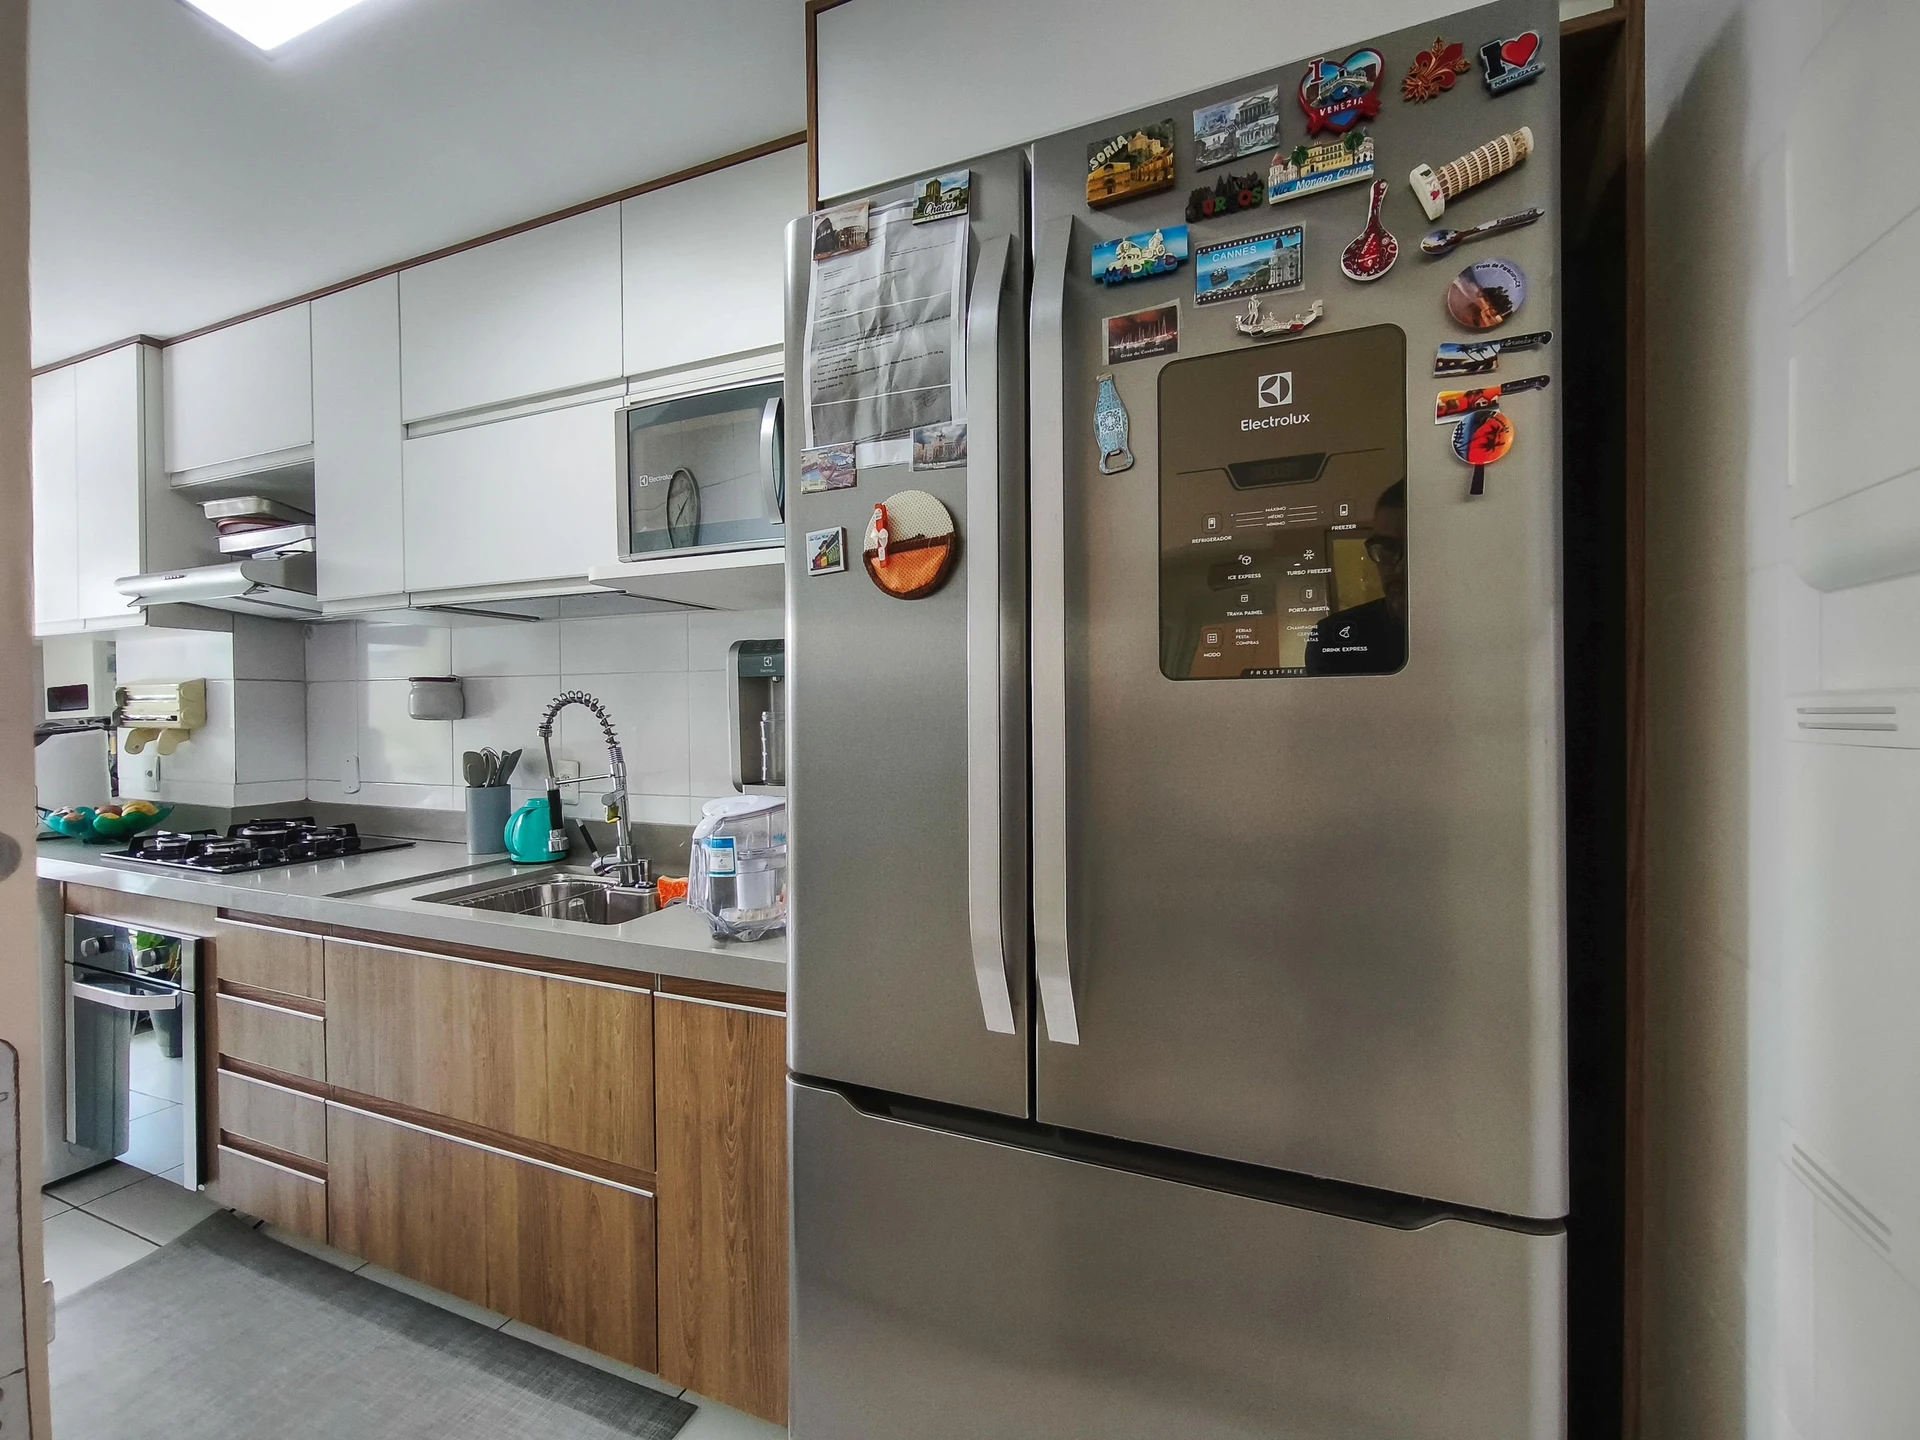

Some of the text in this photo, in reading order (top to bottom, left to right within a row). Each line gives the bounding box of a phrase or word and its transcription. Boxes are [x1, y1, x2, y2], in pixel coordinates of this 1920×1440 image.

[1308, 57, 1325, 85] I
[1319, 96, 1364, 117] VENEZIA
[1088, 134, 1128, 172] SORIA
[1295, 173, 1333, 191] Monaco
[1336, 163, 1373, 181] Cannes
[924, 201, 957, 217] Chaves
[1186, 186, 1264, 222] UROS
[1212, 245, 1257, 262] CANNES
[1103, 252, 1178, 284] MADRID
[1240, 413, 1311, 431] Electrolux
[1191, 535, 1232, 544] REFRIGERADOR
